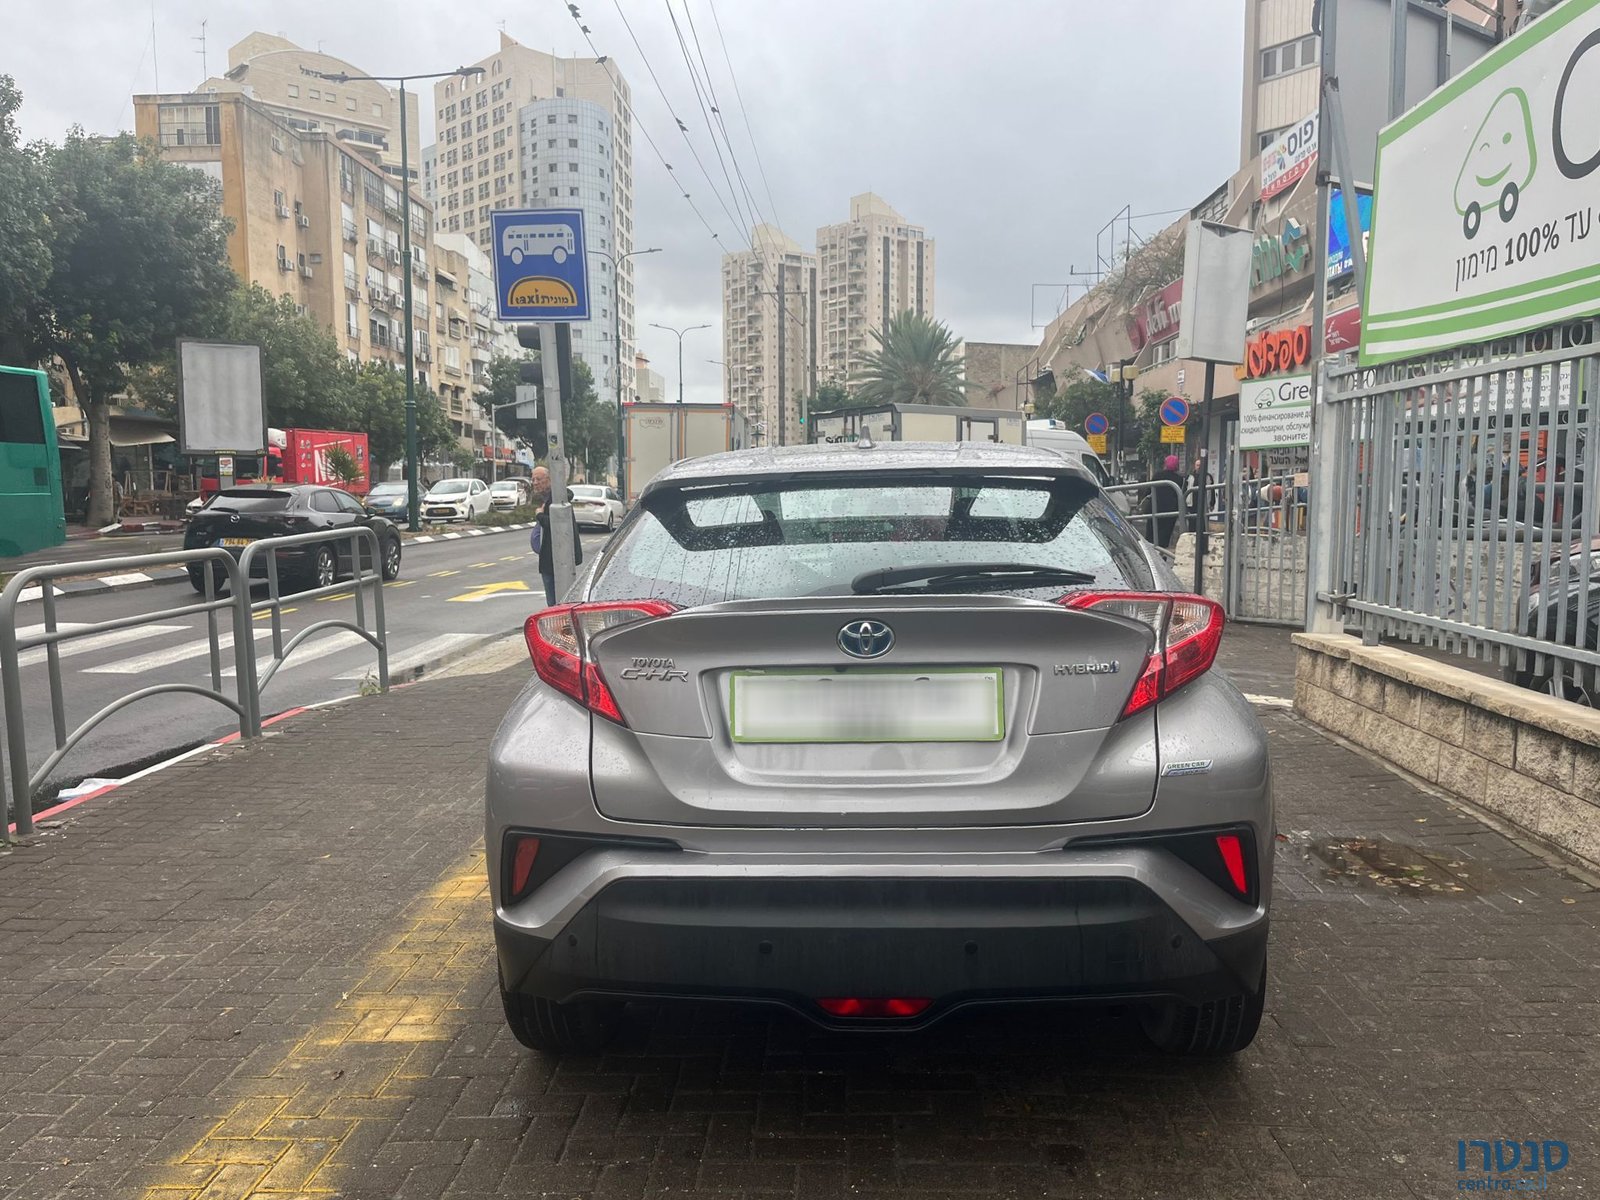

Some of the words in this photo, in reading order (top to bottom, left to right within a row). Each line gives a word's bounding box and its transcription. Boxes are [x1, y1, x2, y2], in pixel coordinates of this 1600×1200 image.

[1565, 207, 1591, 242] עד
[1505, 219, 1560, 266] 100%
[1456, 245, 1497, 292] מימון
[515, 288, 539, 305] taxi
[540, 295, 569, 305] מונית
[1278, 382, 1312, 401] Gre
[1243, 414, 1257, 423] 100%
[631, 657, 676, 669] TOYOTA
[1053, 663, 1110, 676] HYBRID
[621, 668, 689, 682] C-HR
